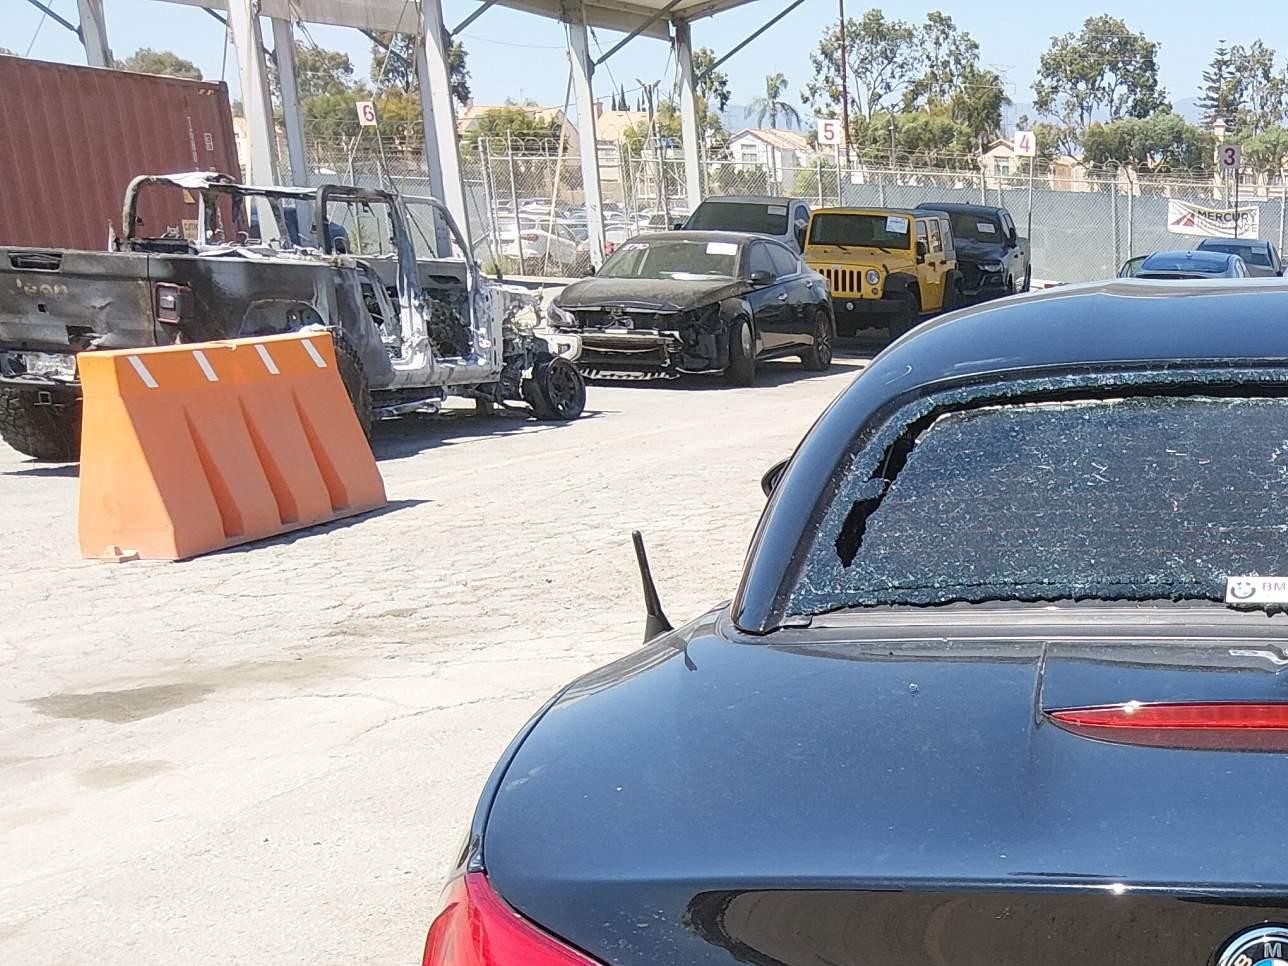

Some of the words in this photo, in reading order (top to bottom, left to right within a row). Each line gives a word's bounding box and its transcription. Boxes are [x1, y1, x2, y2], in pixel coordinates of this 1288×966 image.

[363, 105, 375, 121] 6
[824, 123, 835, 140] 5
[1019, 134, 1031, 152] 4
[1224, 147, 1236, 165] 3
[1197, 209, 1257, 223] MERCURY
